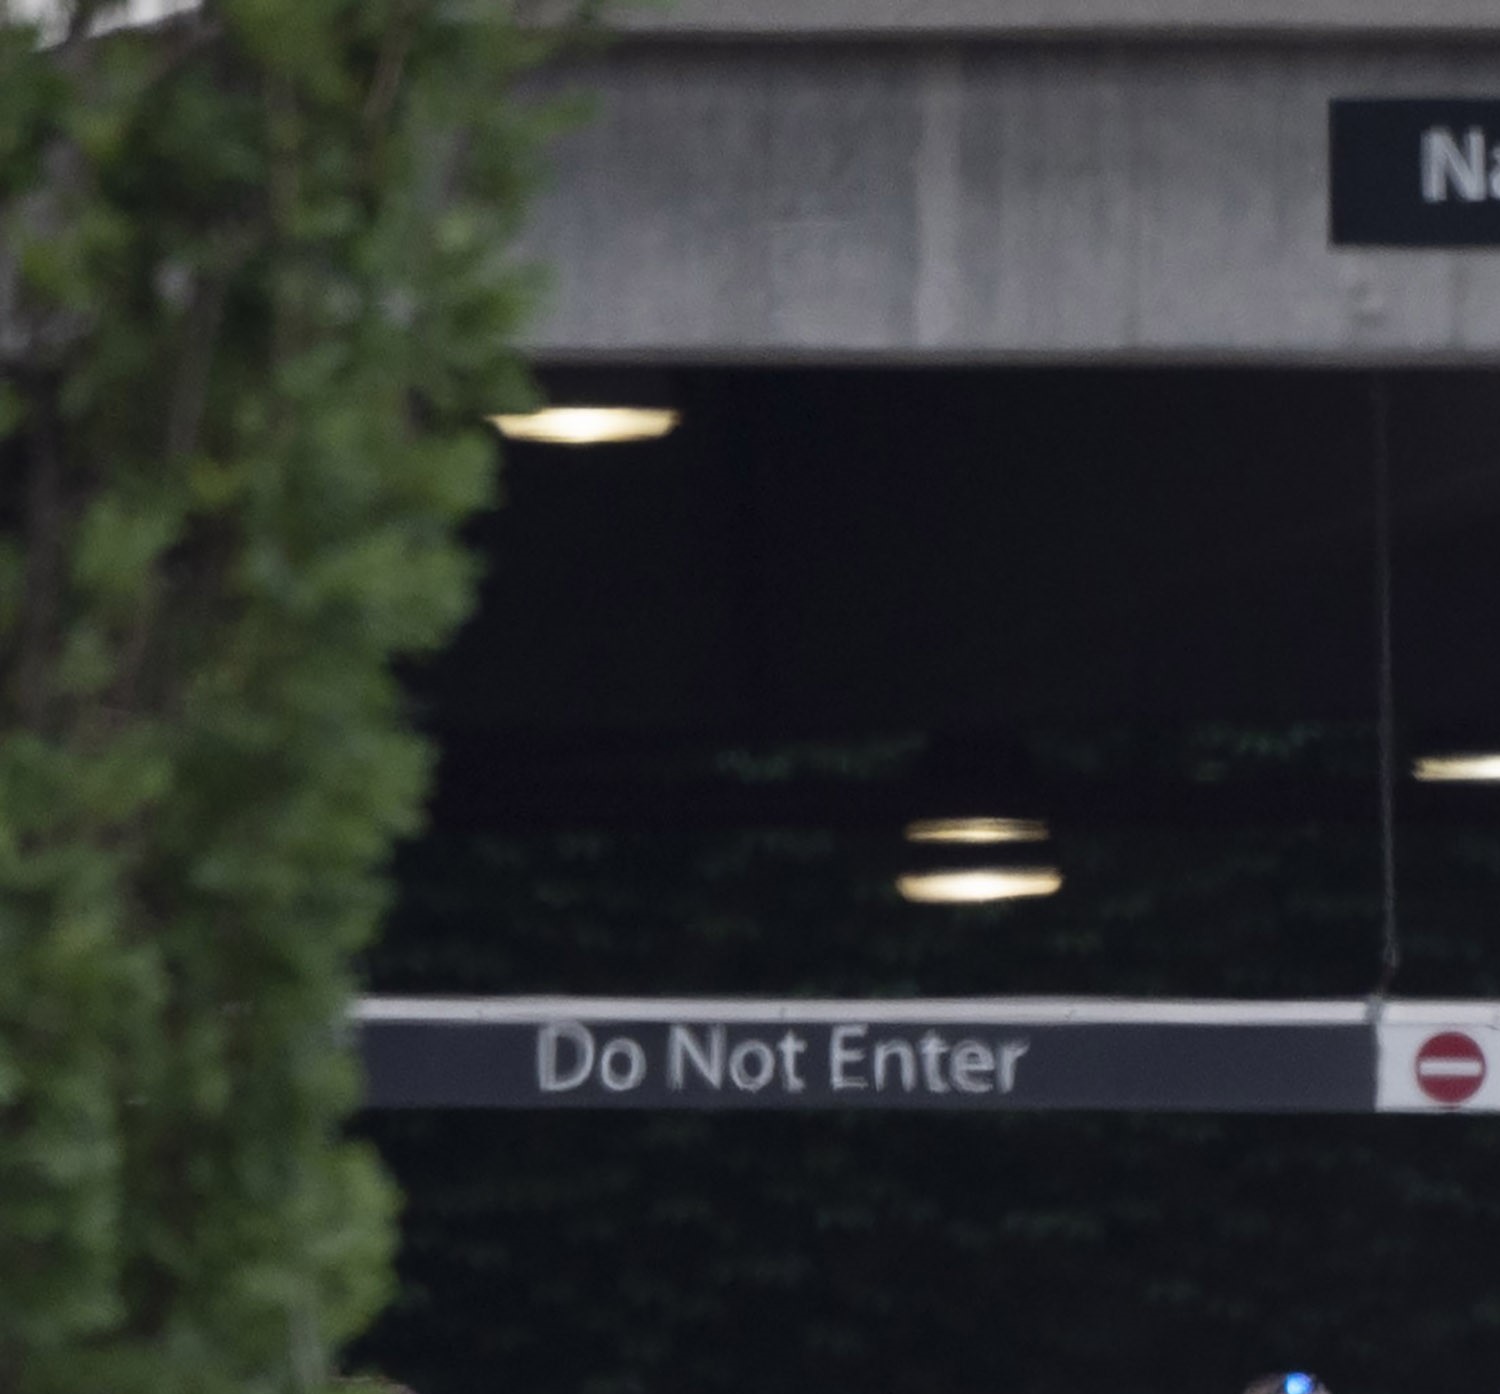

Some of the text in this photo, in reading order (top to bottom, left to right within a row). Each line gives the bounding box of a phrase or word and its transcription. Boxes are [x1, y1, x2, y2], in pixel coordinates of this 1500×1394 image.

[536, 1021, 1030, 1093] Do Not Enter
